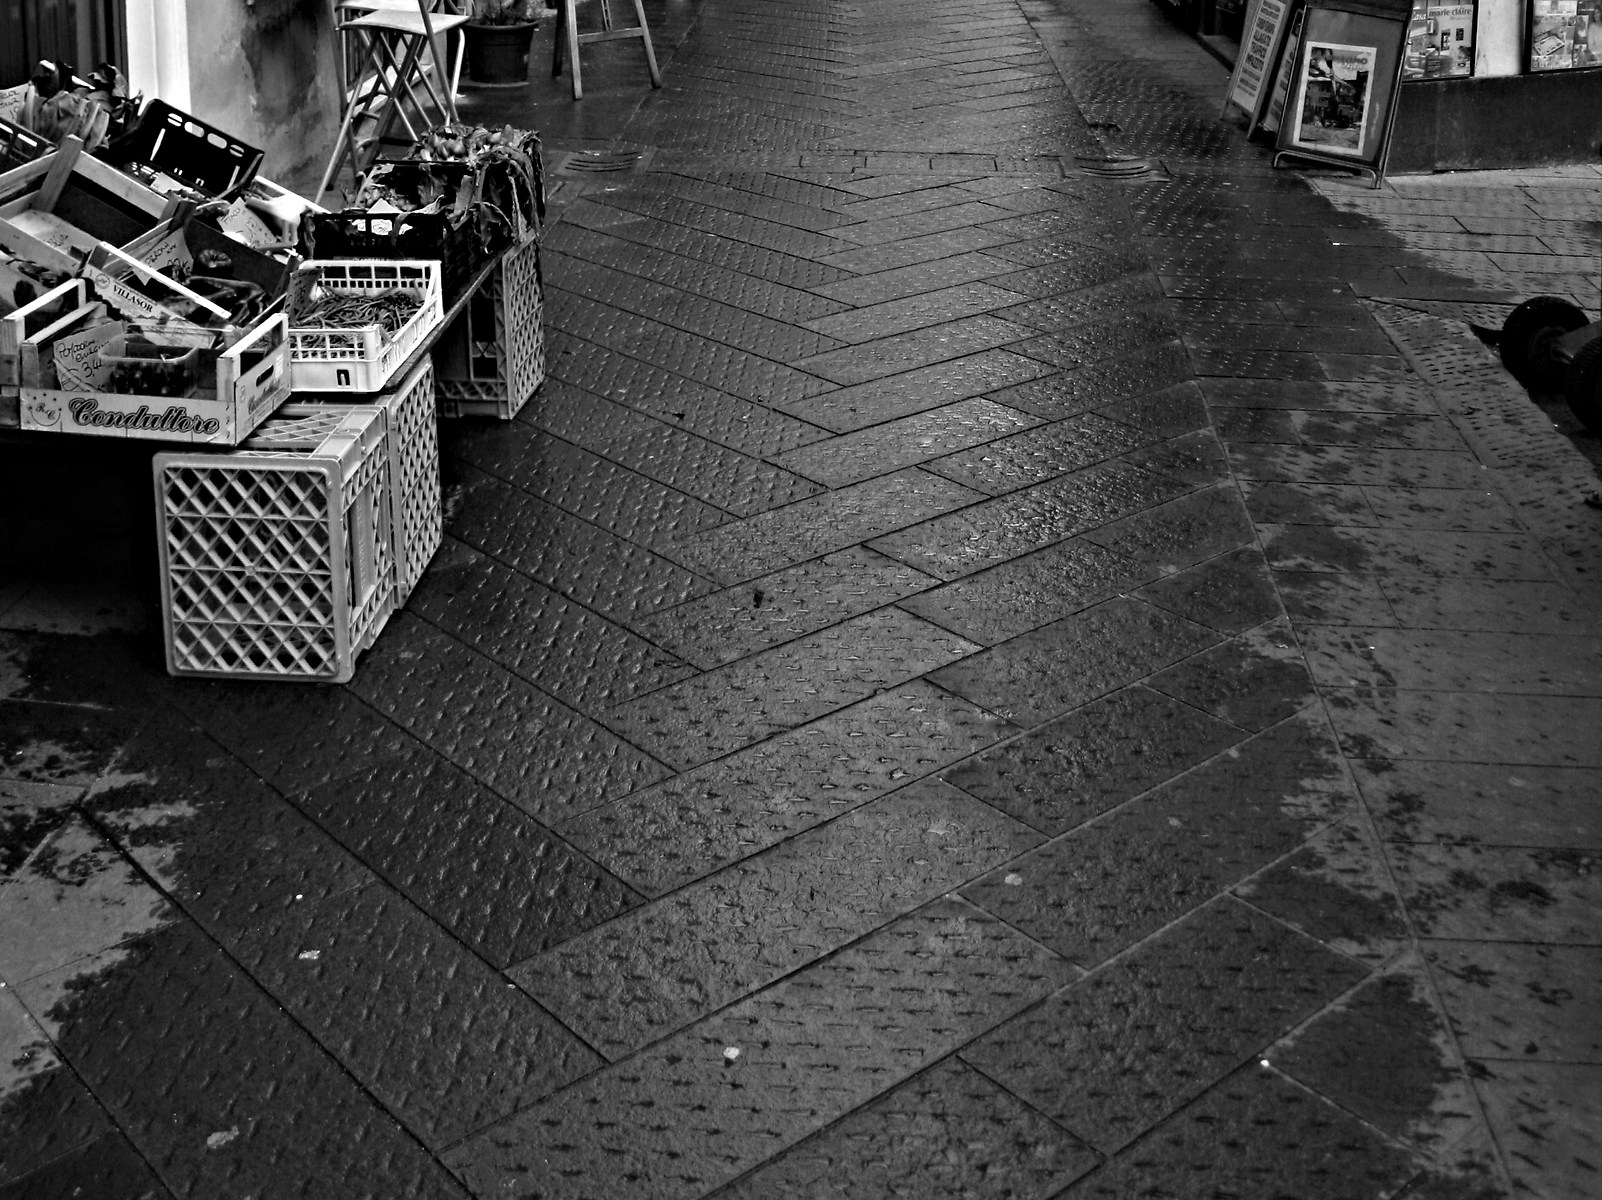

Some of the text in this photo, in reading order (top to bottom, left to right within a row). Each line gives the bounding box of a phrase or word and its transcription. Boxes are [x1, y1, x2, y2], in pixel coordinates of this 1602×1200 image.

[1429, 7, 1472, 17] marie claire
[112, 284, 154, 314] VILLASOR
[68, 397, 220, 435] Conduttore
